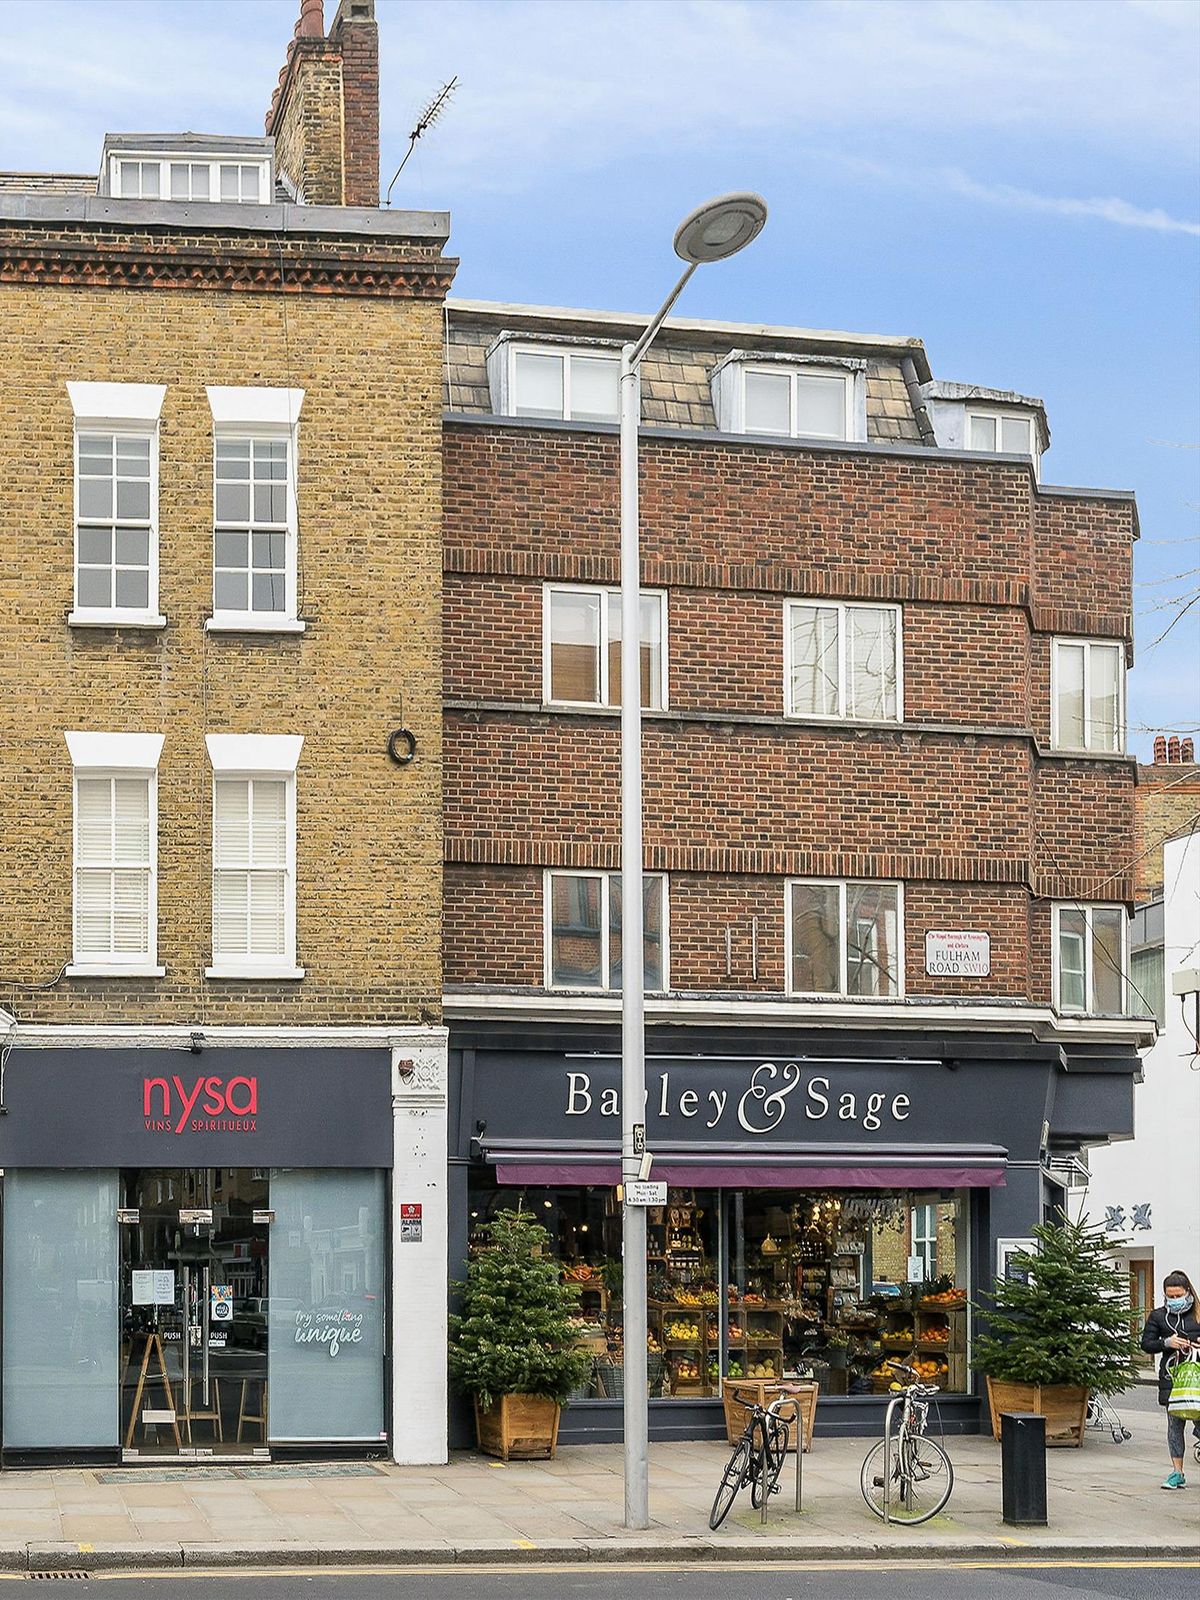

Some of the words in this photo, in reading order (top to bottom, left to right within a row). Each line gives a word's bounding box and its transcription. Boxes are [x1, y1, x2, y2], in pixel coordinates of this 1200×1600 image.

[936, 951, 980, 961] FULHAM
[963, 963, 989, 974] SW10
[143, 1075, 258, 1134] nysa
[565, 1072, 728, 1128] Baley
[737, 1062, 801, 1135] &
[805, 1077, 911, 1131] Sage
[144, 1120, 172, 1132] VINS
[191, 1120, 257, 1132] SPIRITUEUX
[295, 1310, 312, 1328] try
[163, 1331, 181, 1340] PUSH
[210, 1331, 228, 1340] PUSH
[294, 1325, 363, 1357] unique
